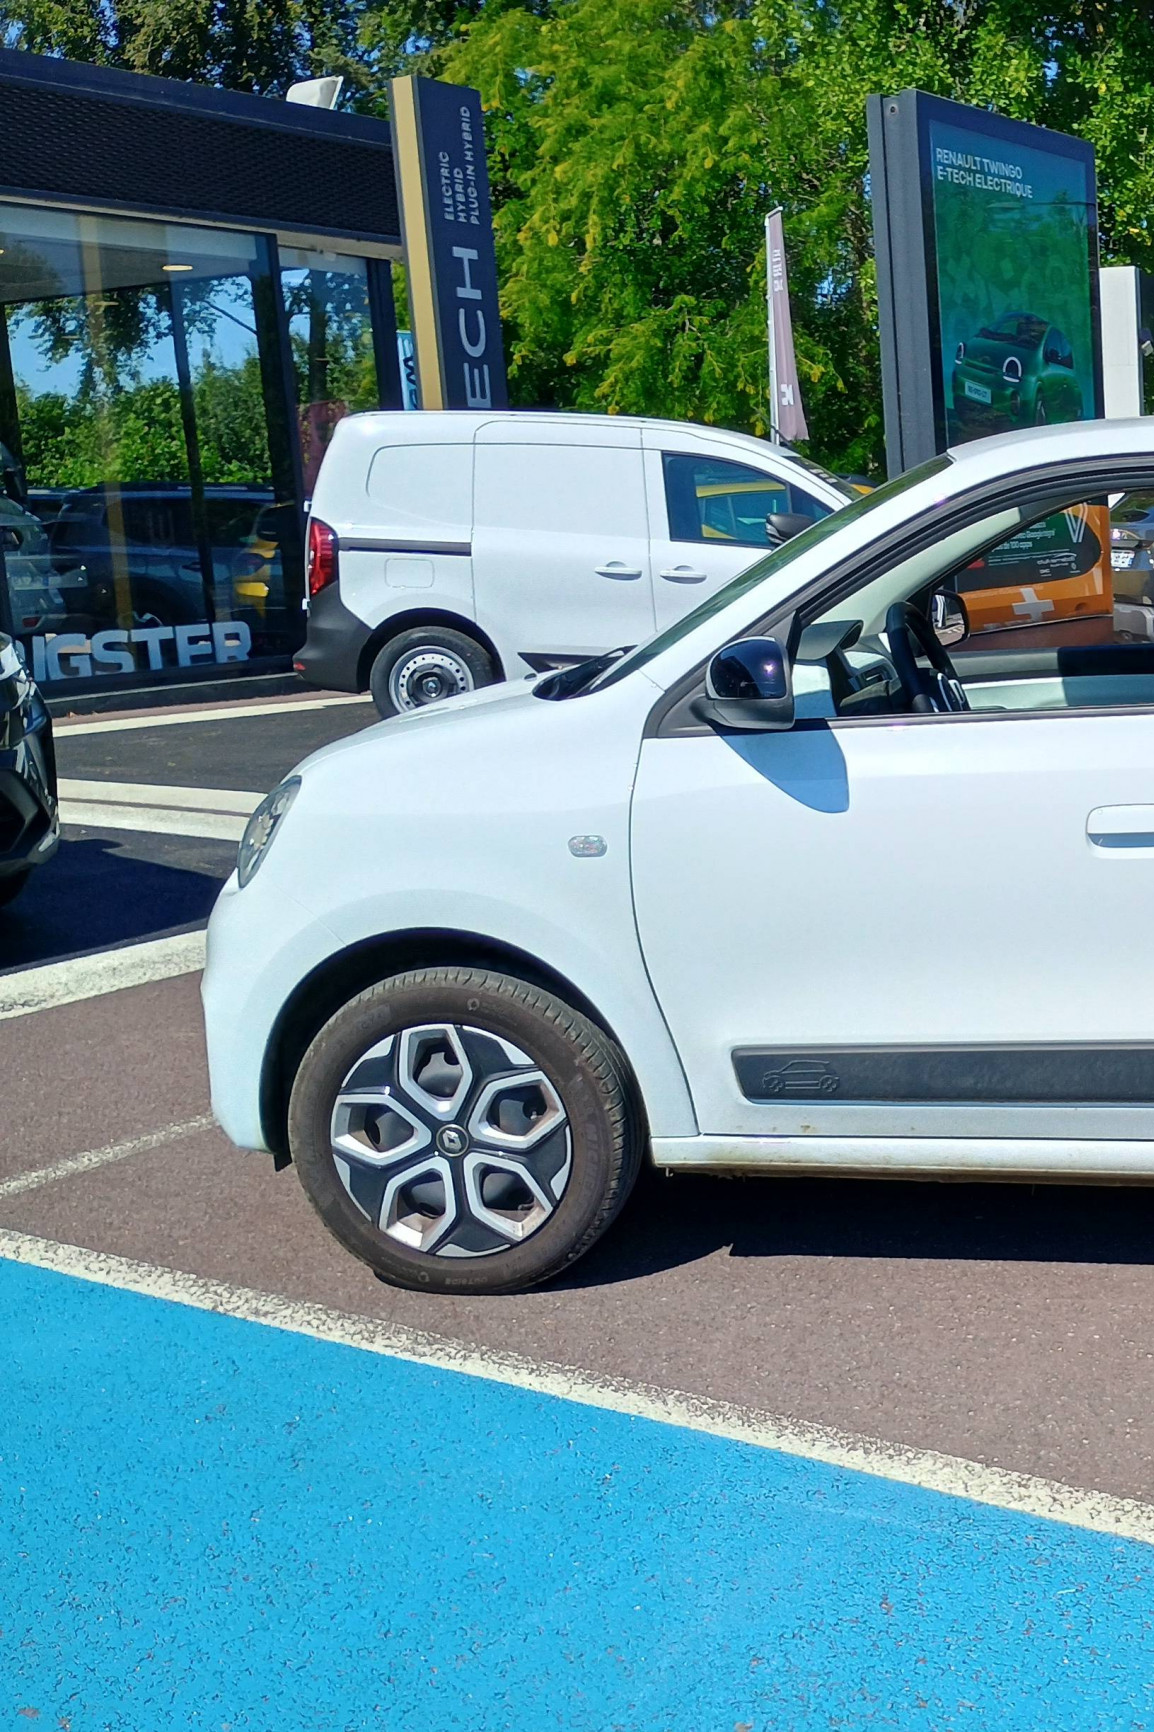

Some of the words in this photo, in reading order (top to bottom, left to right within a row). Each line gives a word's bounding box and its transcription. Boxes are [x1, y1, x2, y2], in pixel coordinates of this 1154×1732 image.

[460, 106, 474, 161] HYBRID
[439, 151, 455, 221] ELECTRIC
[936, 148, 981, 171] RENAULT
[982, 158, 1023, 180] TWINGO
[937, 166, 974, 187] E-TECH
[974, 174, 1033, 199] ELECTRIQUE
[453, 168, 467, 223] HYBRID
[465, 165, 481, 225] PLUG-IN
